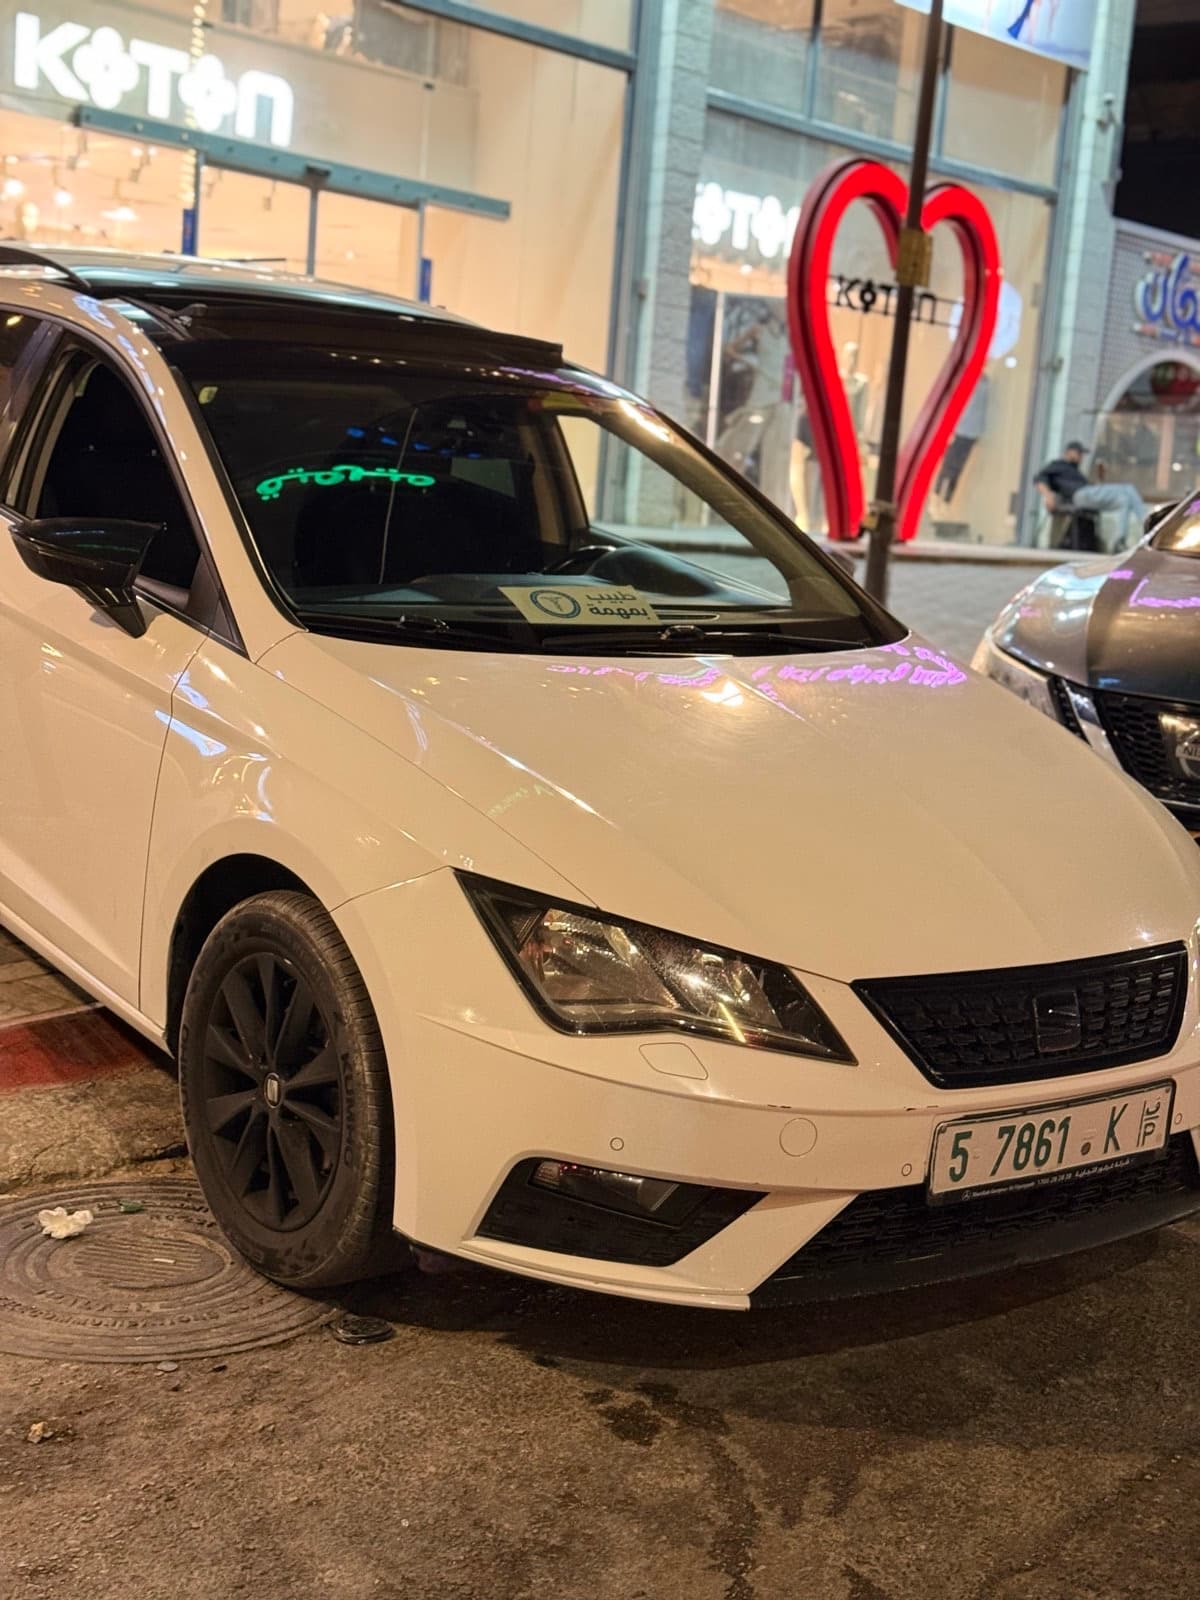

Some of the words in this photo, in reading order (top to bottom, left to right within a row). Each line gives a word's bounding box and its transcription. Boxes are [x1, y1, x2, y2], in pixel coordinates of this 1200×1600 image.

[834, 275, 939, 325] KOTN
[585, 590, 637, 605] طبيب
[587, 602, 651, 620] بمهمة
[949, 1130, 973, 1182] 5
[989, 1115, 1072, 1177] 7861
[1104, 1102, 1128, 1154] K
[1141, 1121, 1156, 1147] P
